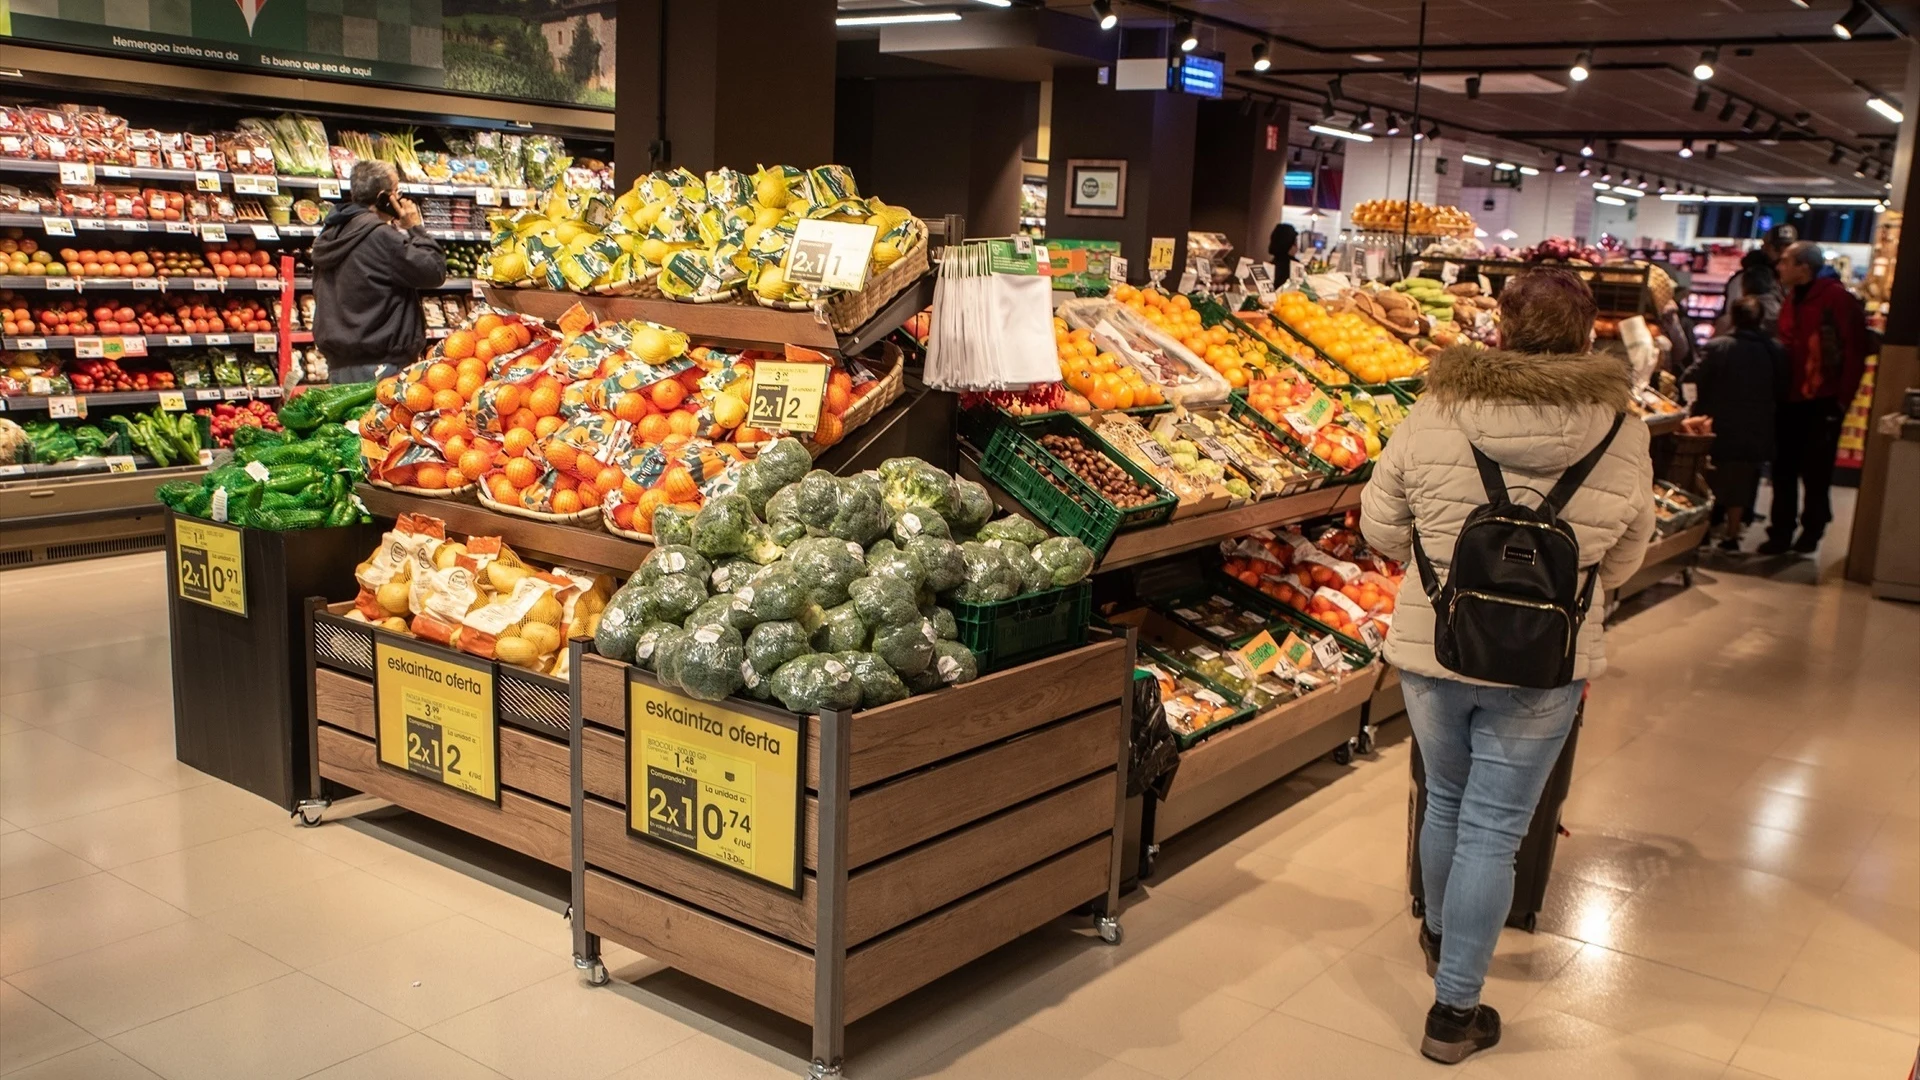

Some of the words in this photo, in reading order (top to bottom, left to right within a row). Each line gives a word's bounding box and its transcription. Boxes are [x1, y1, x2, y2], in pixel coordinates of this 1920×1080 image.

[112, 36, 170, 54] Hemengoa
[173, 42, 202, 56] izatea
[204, 50, 224, 58] ona
[226, 51, 239, 61] da
[261, 54, 270, 64] Es
[272, 56, 301, 68] bueno
[303, 61, 320, 73] que
[322, 63, 338, 72] sea
[339, 64, 351, 74] de
[352, 66, 372, 77] aquí
[792, 251, 825, 274] 2x1
[754, 396, 783, 418] 2x1
[786, 398, 800, 418] 2
[183, 560, 208, 588] 2x1
[388, 657, 442, 683] eskaintza
[446, 672, 481, 696] oferta
[454, 731, 471, 742] unidad
[646, 700, 723, 737] eskaintza
[729, 726, 780, 755] oferta
[408, 733, 440, 767] 2x1
[446, 744, 461, 776] 2
[650, 768, 681, 784] Comprando
[705, 784, 713, 794] La
[714, 786, 738, 801] unidad
[650, 788, 693, 832] 2x1
[702, 803, 752, 840] 0,74
[734, 836, 751, 849] €/Ud
[722, 851, 745, 866] 13-Dic
